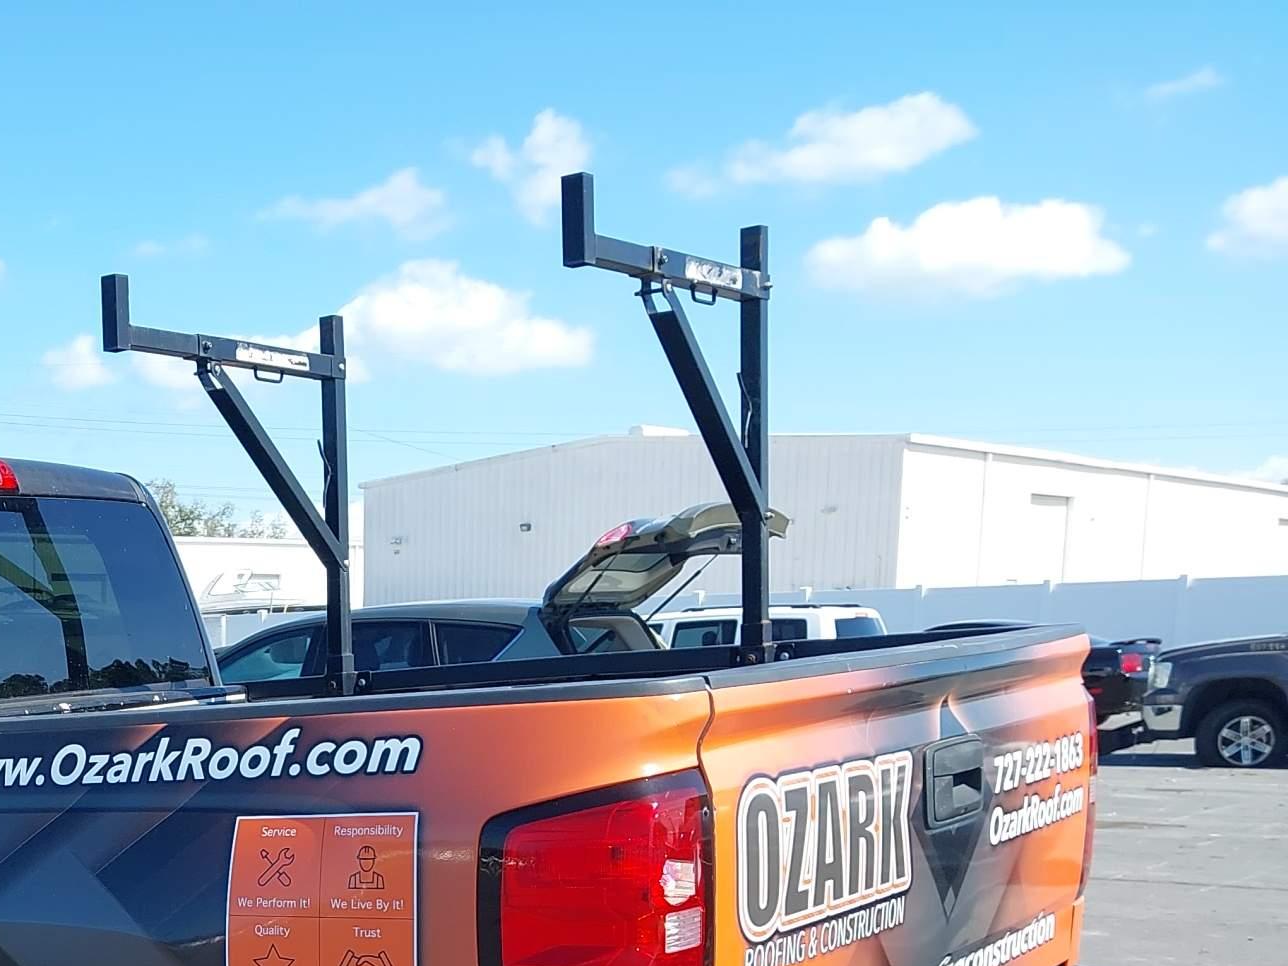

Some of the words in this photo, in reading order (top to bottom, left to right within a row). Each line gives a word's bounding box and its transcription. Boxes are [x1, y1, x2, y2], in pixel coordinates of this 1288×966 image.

[993, 732, 1084, 794] 727-222-1863
[989, 783, 1084, 846] OzarkRoof.com
[261, 826, 297, 838] Service
[333, 824, 404, 839] Responsibility
[737, 750, 913, 943] OZARK
[237, 897, 253, 908] We
[256, 897, 297, 909] Perform
[299, 897, 311, 909] It!
[330, 898, 348, 910] We
[351, 898, 374, 910] Live
[376, 898, 390, 912] By
[392, 899, 404, 910] It!
[254, 924, 291, 938] Quality
[352, 926, 382, 938] Trust
[807, 926, 818, 959] &
[820, 896, 906, 954] CONSTRUCTION
